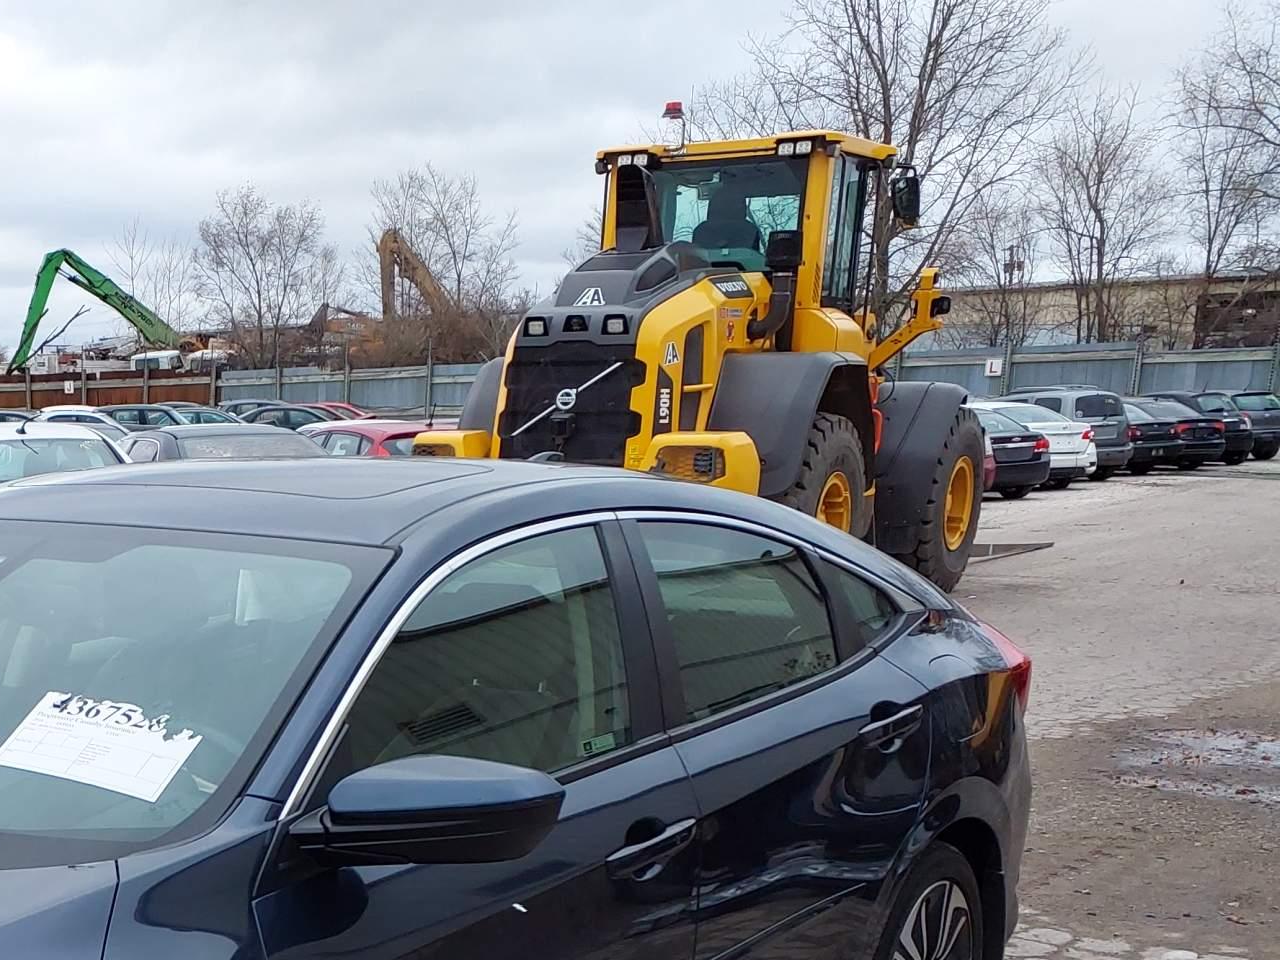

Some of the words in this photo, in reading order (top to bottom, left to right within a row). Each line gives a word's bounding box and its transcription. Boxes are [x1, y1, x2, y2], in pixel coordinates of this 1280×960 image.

[717, 281, 747, 292] VOLVO
[989, 361, 998, 374] L
[659, 388, 671, 424] L90H
